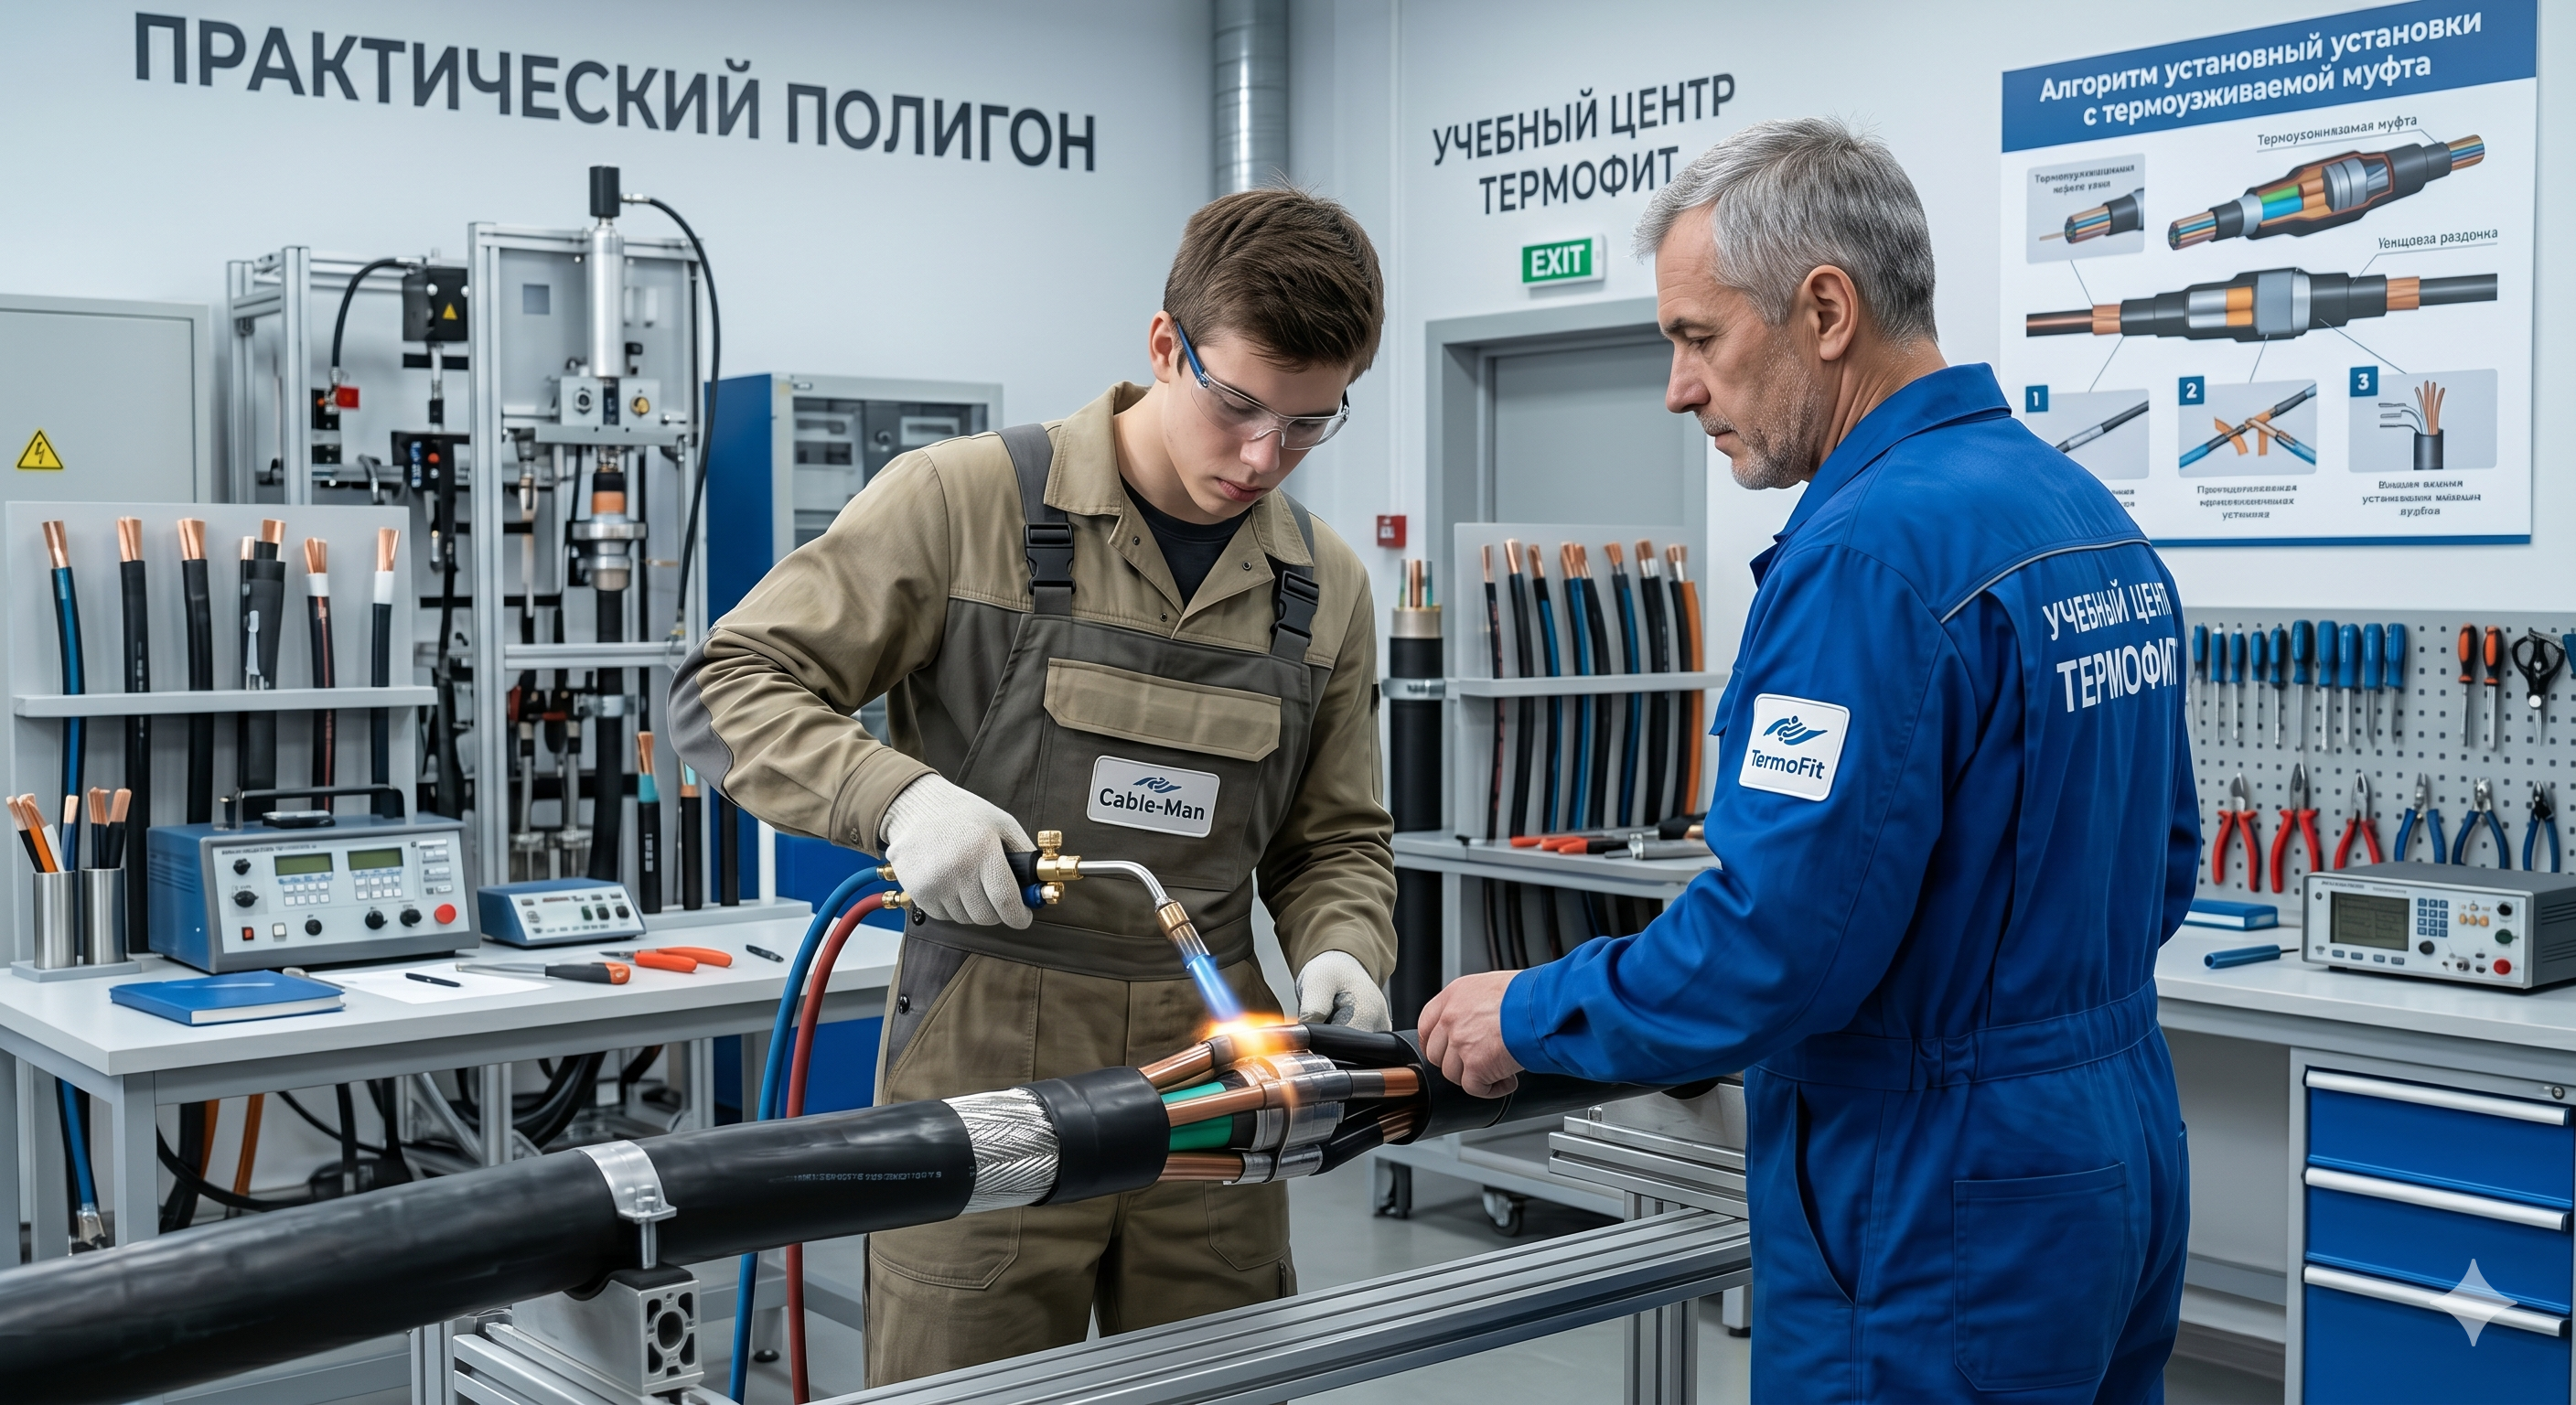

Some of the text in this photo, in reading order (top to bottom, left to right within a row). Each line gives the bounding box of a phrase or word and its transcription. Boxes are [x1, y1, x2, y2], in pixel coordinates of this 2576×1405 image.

[2039, 12, 2482, 102] Алгоритм установный установки
[135, 12, 1095, 172] ПРАКТИЧЕСКИЙ ПОЛИГОН
[2083, 54, 2431, 126] с термоузживаемой муфта
[1433, 73, 1735, 166] УЧЕБНЫЙ ЦЕНТР
[2377, 115, 2418, 133] муфта
[1478, 145, 1680, 215] ТЕРМОФИТ
[1530, 244, 1586, 278] EXIT
[2032, 391, 2040, 407] 1
[2186, 382, 2197, 399] 2
[2357, 372, 2369, 391] 3
[2042, 578, 2131, 641] УЧЕБНЫЙ
[2056, 638, 2178, 713] ТЕРМОФИТ
[1751, 749, 1826, 780] TermoFit
[1099, 788, 1206, 820] Cable-Man
